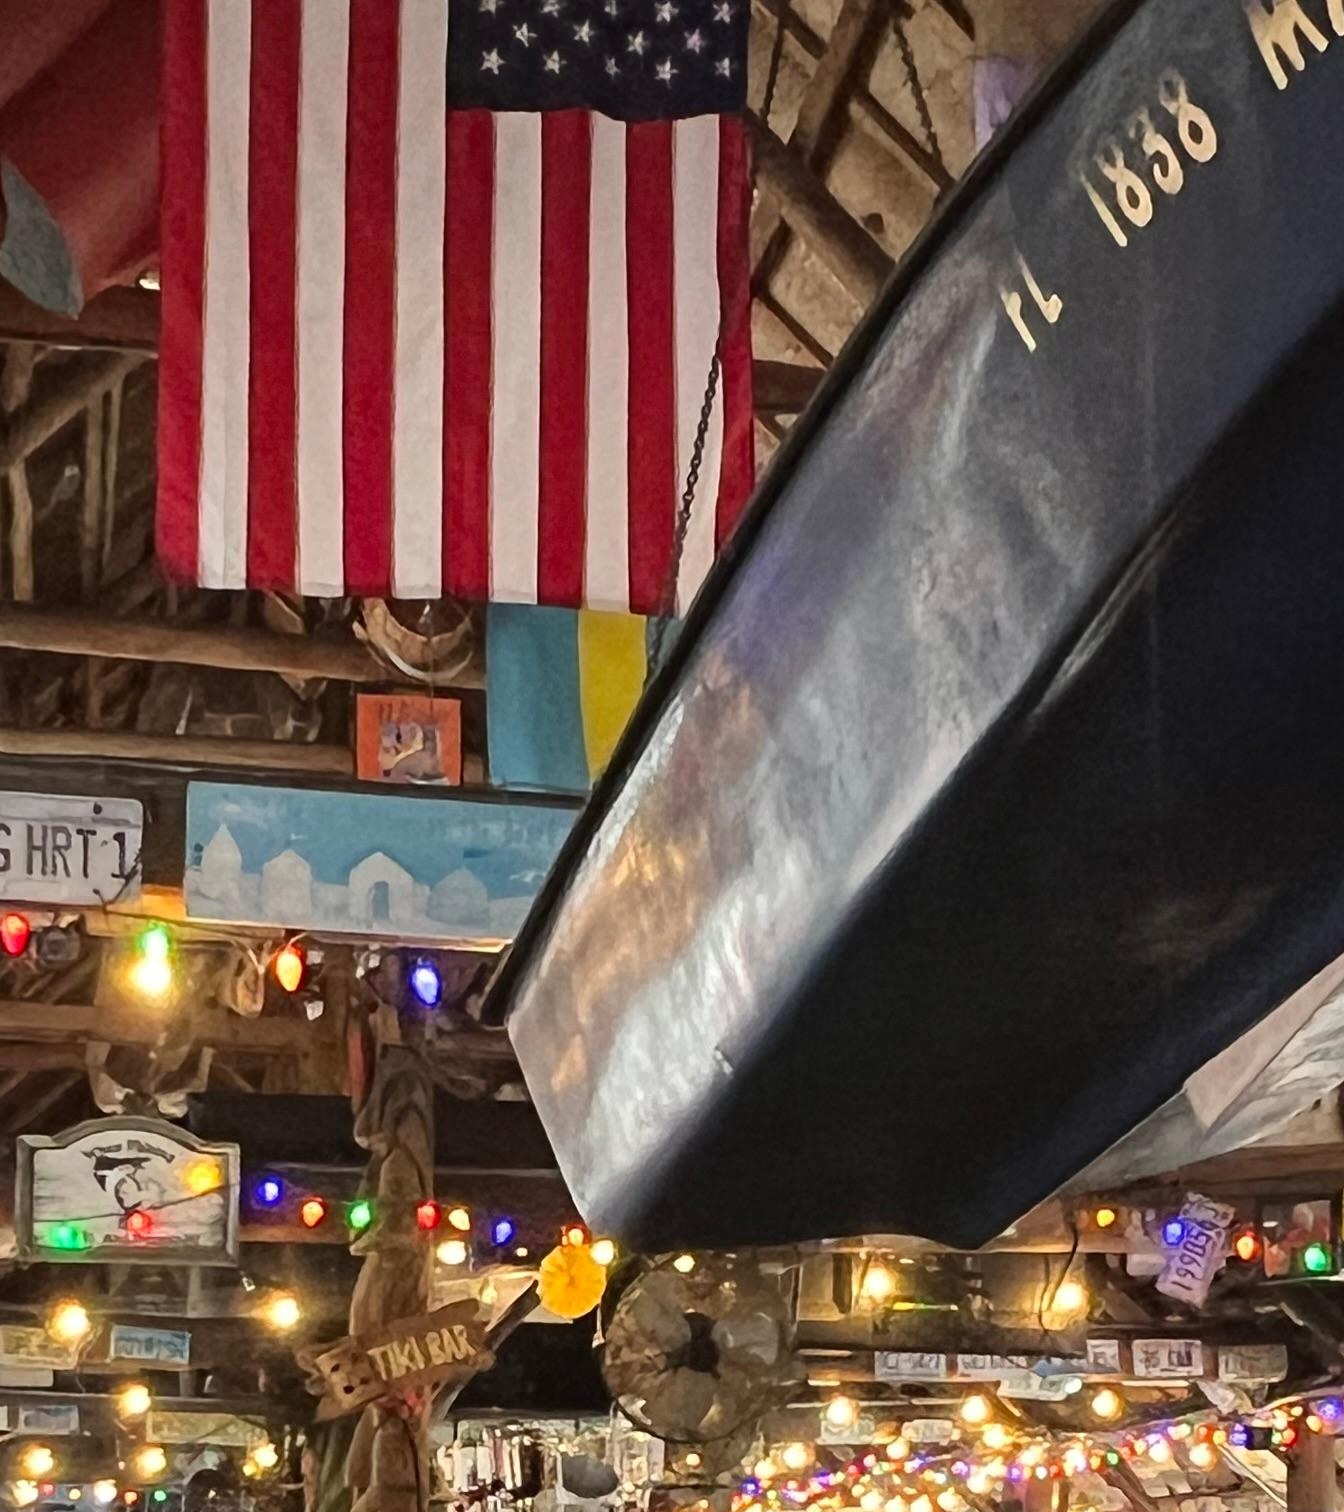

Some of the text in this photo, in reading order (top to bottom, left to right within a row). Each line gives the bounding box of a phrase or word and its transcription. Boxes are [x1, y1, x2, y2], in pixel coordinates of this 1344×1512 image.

[26, 824, 97, 880] HRT
[110, 832, 131, 881] 1
[367, 1325, 477, 1381] TIKI BAR
